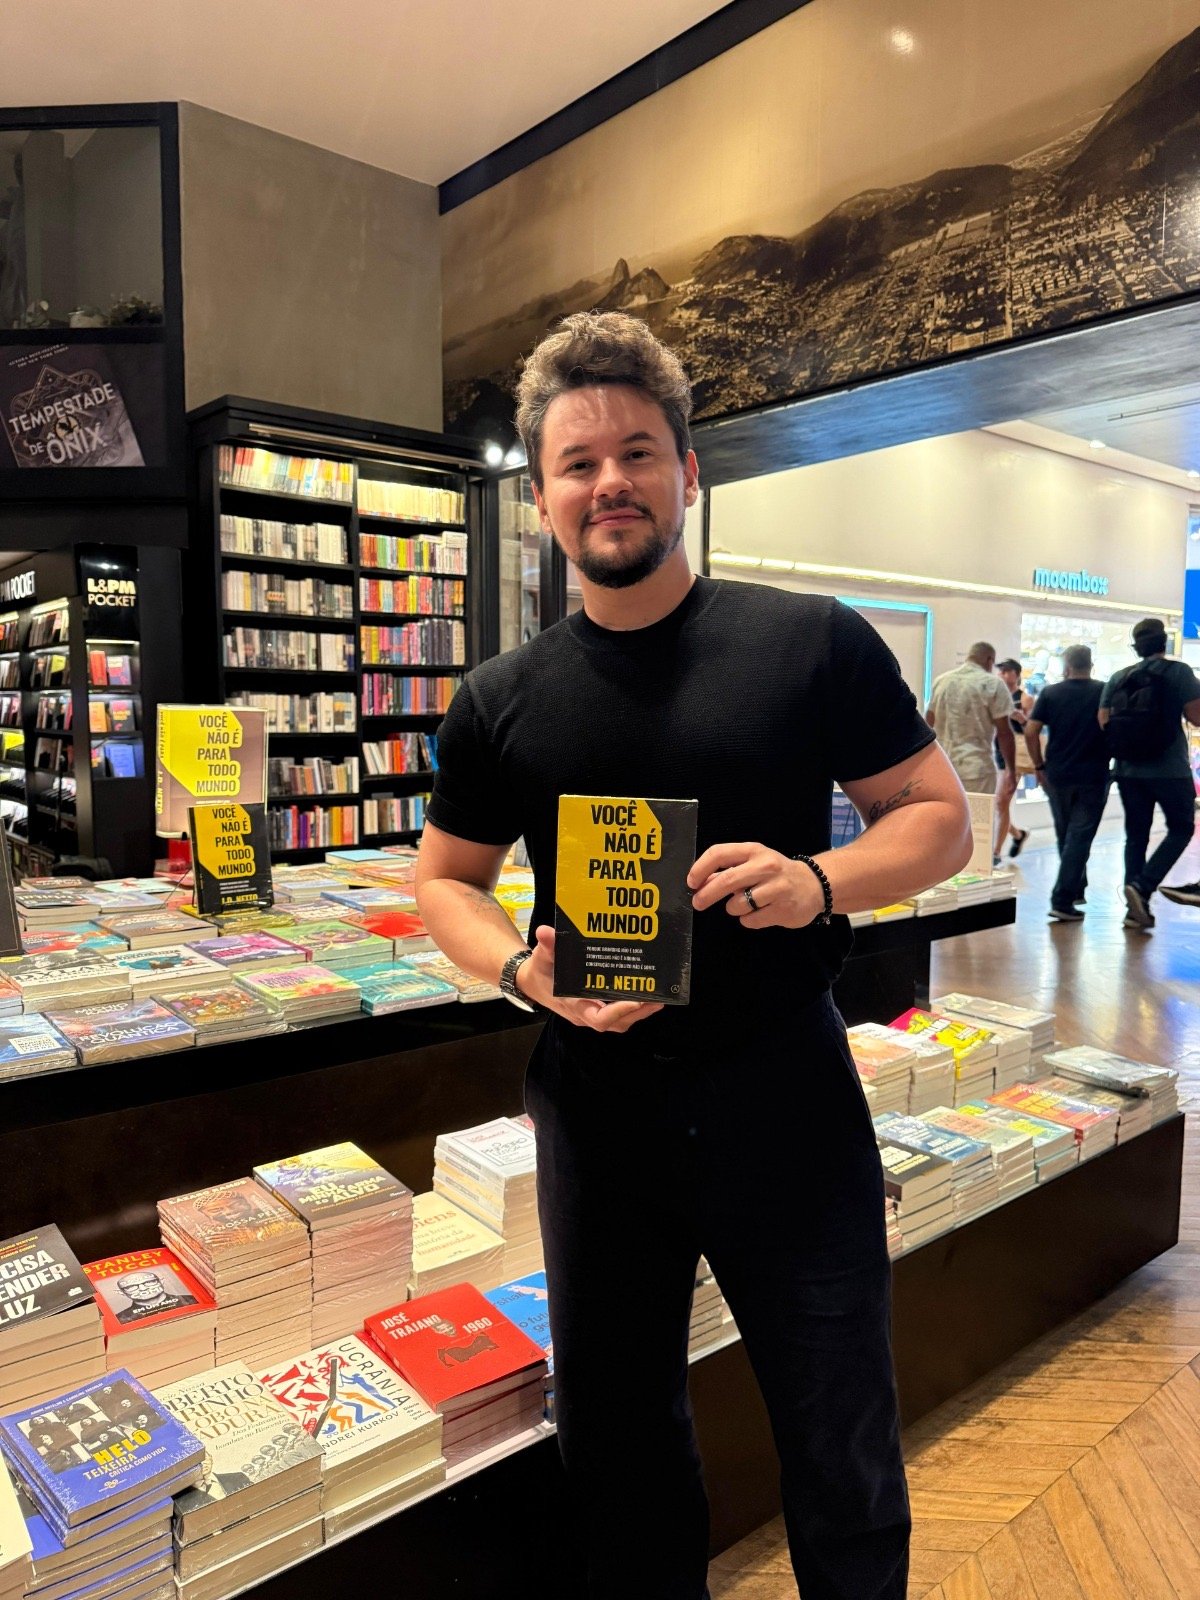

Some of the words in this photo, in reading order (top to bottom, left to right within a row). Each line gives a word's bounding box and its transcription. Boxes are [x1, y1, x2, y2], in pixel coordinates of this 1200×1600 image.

[8, 382, 116, 434] TEMPESTADE
[29, 442, 45, 455] DE
[46, 422, 107, 464] ÔNIX
[11, 570, 36, 600] POCKET
[87, 578, 137, 595] L&PM
[1034, 567, 1109, 595] moombox
[87, 593, 137, 607] POCKET
[199, 712, 227, 728] VOCÊ
[207, 729, 229, 745] NÃO
[233, 729, 239, 744] É
[197, 748, 227, 760] PARA
[208, 764, 237, 776] TODO
[196, 780, 236, 793] MUNDO
[212, 805, 237, 819] VOCÊ
[591, 800, 637, 826] VOCÊ
[221, 819, 240, 833] NÃO
[242, 818, 249, 831] É
[215, 835, 240, 847] PARA
[604, 827, 641, 853] NÃO
[646, 828, 657, 854] É
[226, 849, 251, 860] TODO
[218, 863, 252, 875] MUNDO
[588, 859, 637, 880] PARA
[606, 887, 654, 908] TODO
[587, 912, 653, 935] MUNDO
[585, 973, 610, 990] J.D.
[613, 975, 656, 992] NETTO
[332, 1184, 380, 1203] ALVO
[346, 1176, 387, 1192] ARMA
[216, 1216, 256, 1231] NOSSA
[0, 1249, 55, 1281] CISA
[82, 1251, 162, 1275] STANLEY
[97, 1259, 159, 1277] TUCCI
[388, 1314, 442, 1340] TRAJANO
[462, 1317, 493, 1334] 1960
[338, 1342, 412, 1406] UCRÂNIA
[178, 1383, 264, 1422] RINHO
[199, 1404, 284, 1440] ADURA
[321, 1430, 356, 1450] NDREI
[358, 1410, 400, 1433] KURKOV
[133, 1454, 153, 1466] COMO
[151, 1446, 167, 1457] VIDA
[82, 1453, 138, 1480] TEIXEIRA
